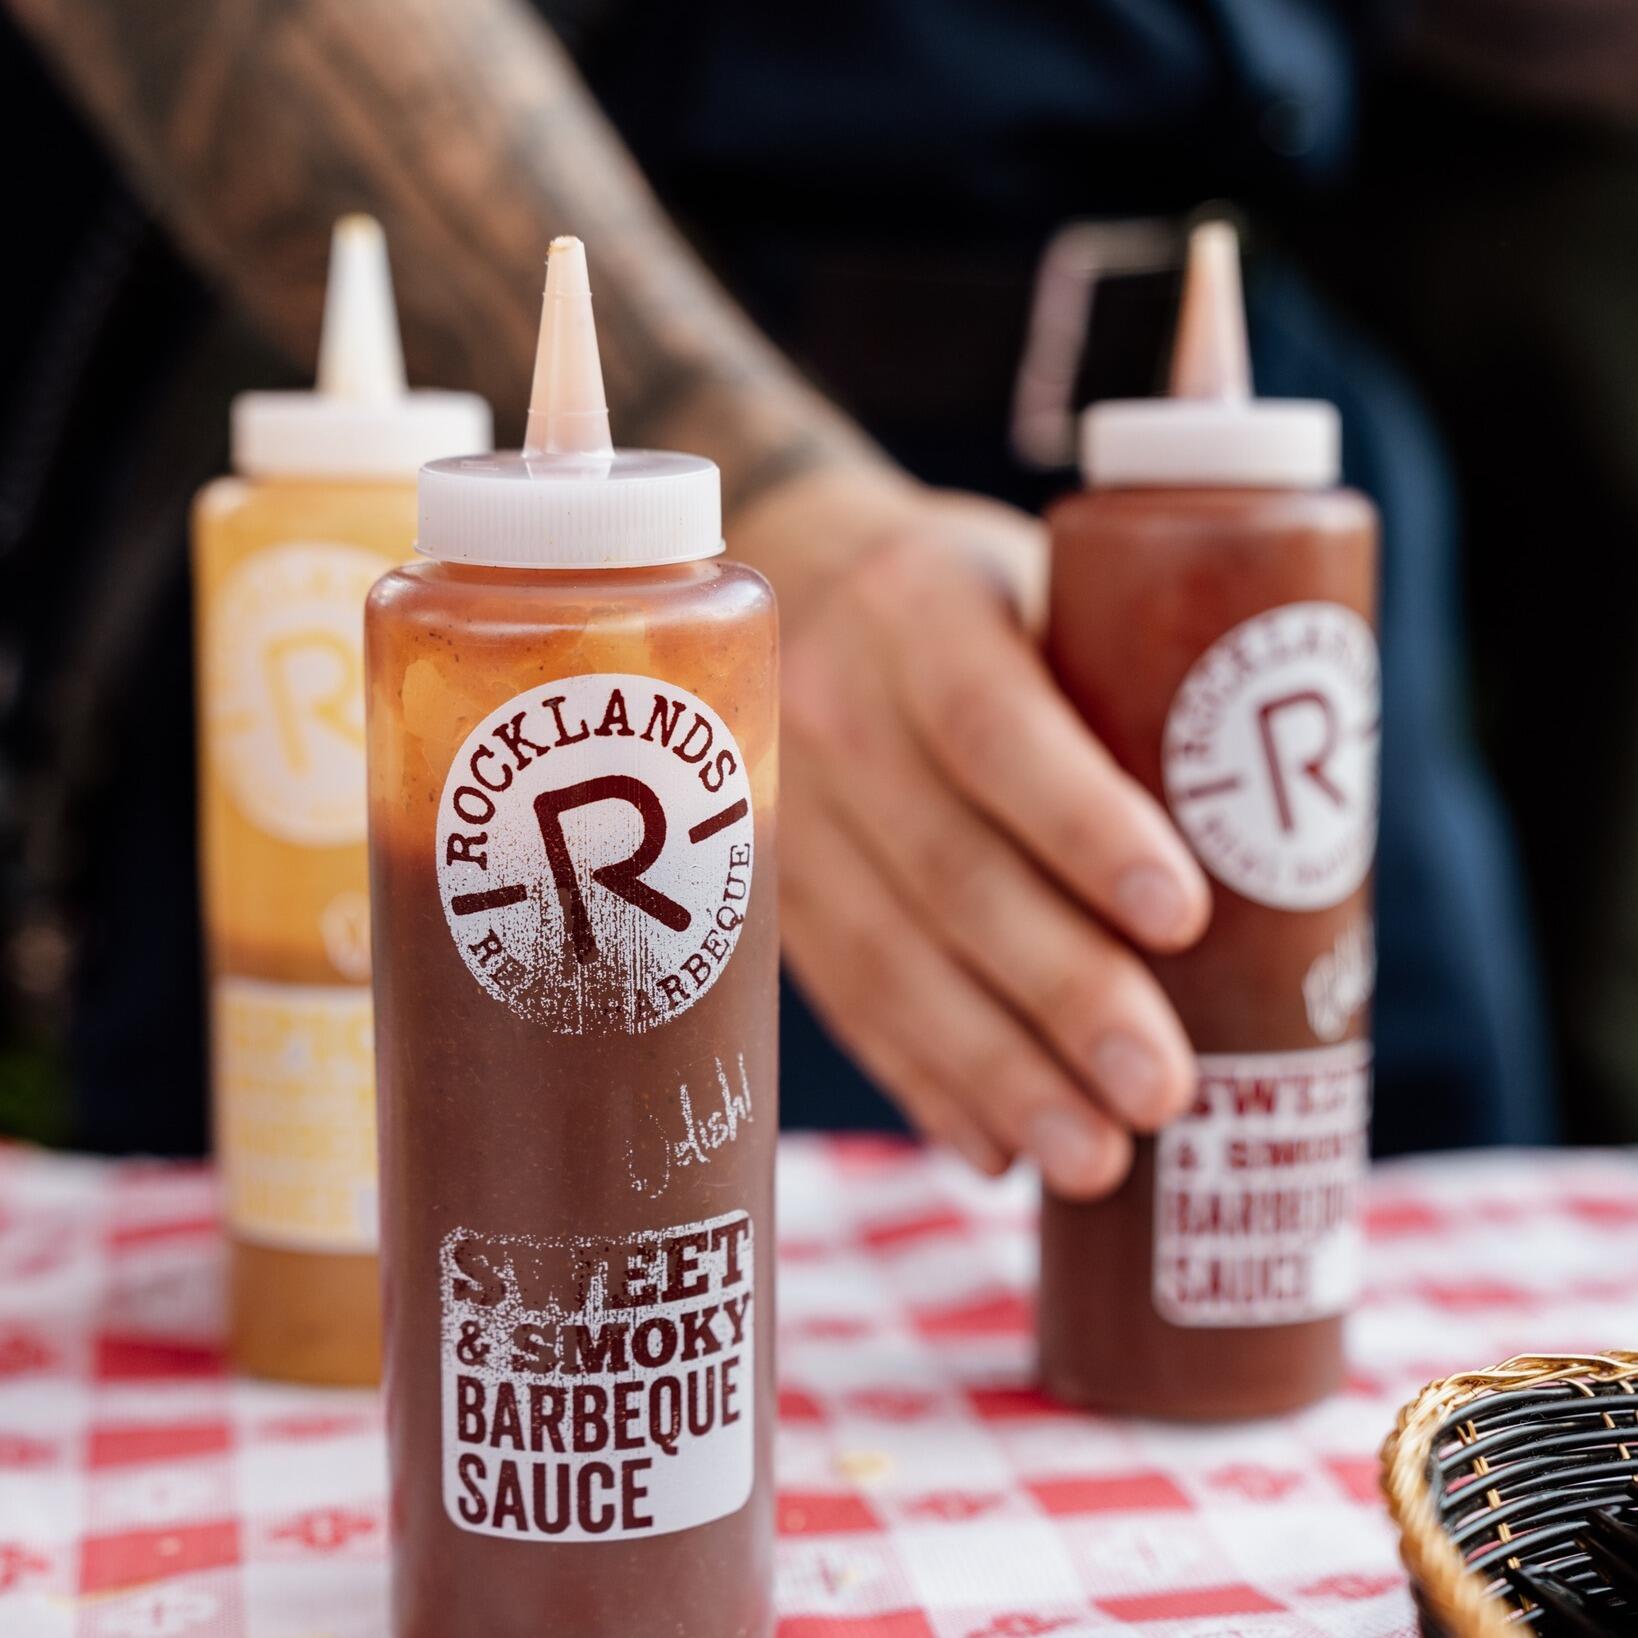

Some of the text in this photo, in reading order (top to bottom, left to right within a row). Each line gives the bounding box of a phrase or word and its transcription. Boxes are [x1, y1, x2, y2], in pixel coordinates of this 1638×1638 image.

[446, 688, 737, 871] ROCKLANDS
[1257, 688, 1345, 840] R
[533, 774, 692, 965] R
[456, 1292, 750, 1375] & SMOKY
[457, 1355, 741, 1456] BARBEQUE
[457, 1452, 654, 1535] SAUCE
